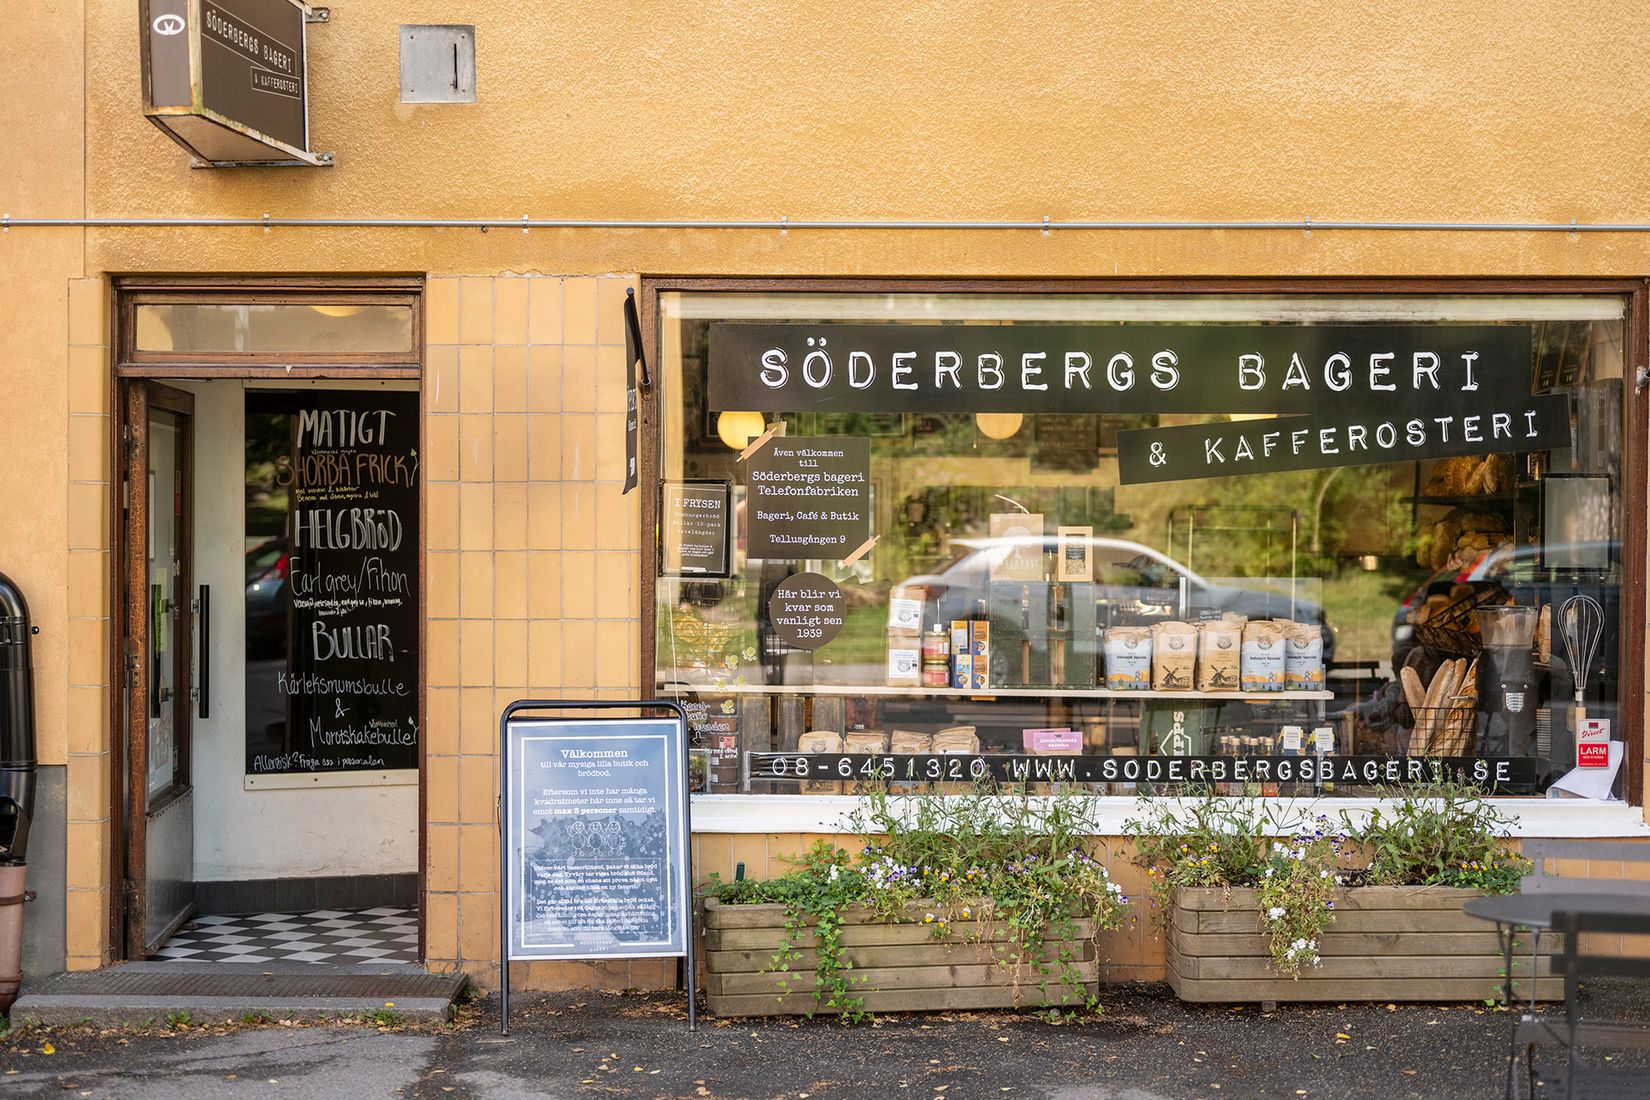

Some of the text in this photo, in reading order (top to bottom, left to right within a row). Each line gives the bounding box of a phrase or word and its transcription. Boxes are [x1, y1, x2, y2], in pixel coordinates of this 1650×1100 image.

[206, 10, 292, 73] SÖDERBERGS BAGERI
[261, 75, 298, 94] KAFFEROSTERI
[760, 336, 1481, 392] SÖDERBERGS BAGERI
[297, 409, 397, 448] MATIGT
[1148, 408, 1539, 467] & KAFFEROSTERI
[773, 448, 844, 457] Även välkommen
[799, 458, 818, 467] till
[276, 453, 351, 488] SHORBA
[752, 471, 865, 484] Söderbergs bageri
[757, 484, 859, 497] Telefonfabriken
[674, 498, 721, 510] I FRYSEN
[757, 510, 859, 521] Bageri, Café & Butik
[769, 533, 846, 546] Tellusgången 9
[290, 556, 321, 597] Earl
[777, 589, 842, 600] Här blir vi
[784, 602, 834, 613] kvar som
[776, 615, 843, 628] vanligt sen
[796, 628, 823, 639] 1939
[312, 620, 395, 662] BULLAR
[335, 698, 351, 719] &
[560, 749, 628, 759] Välkommen
[1580, 747, 1607, 755] LARM
[568, 761, 596, 769] mysiga
[772, 757, 1511, 782] 08-6451320 WWW.SODERBERGSBAGERISE
[577, 769, 612, 777] brödbod.
[542, 788, 579, 796] Eftersom
[605, 787, 620, 795] har
[621, 787, 648, 796] många
[581, 807, 617, 816] personer
